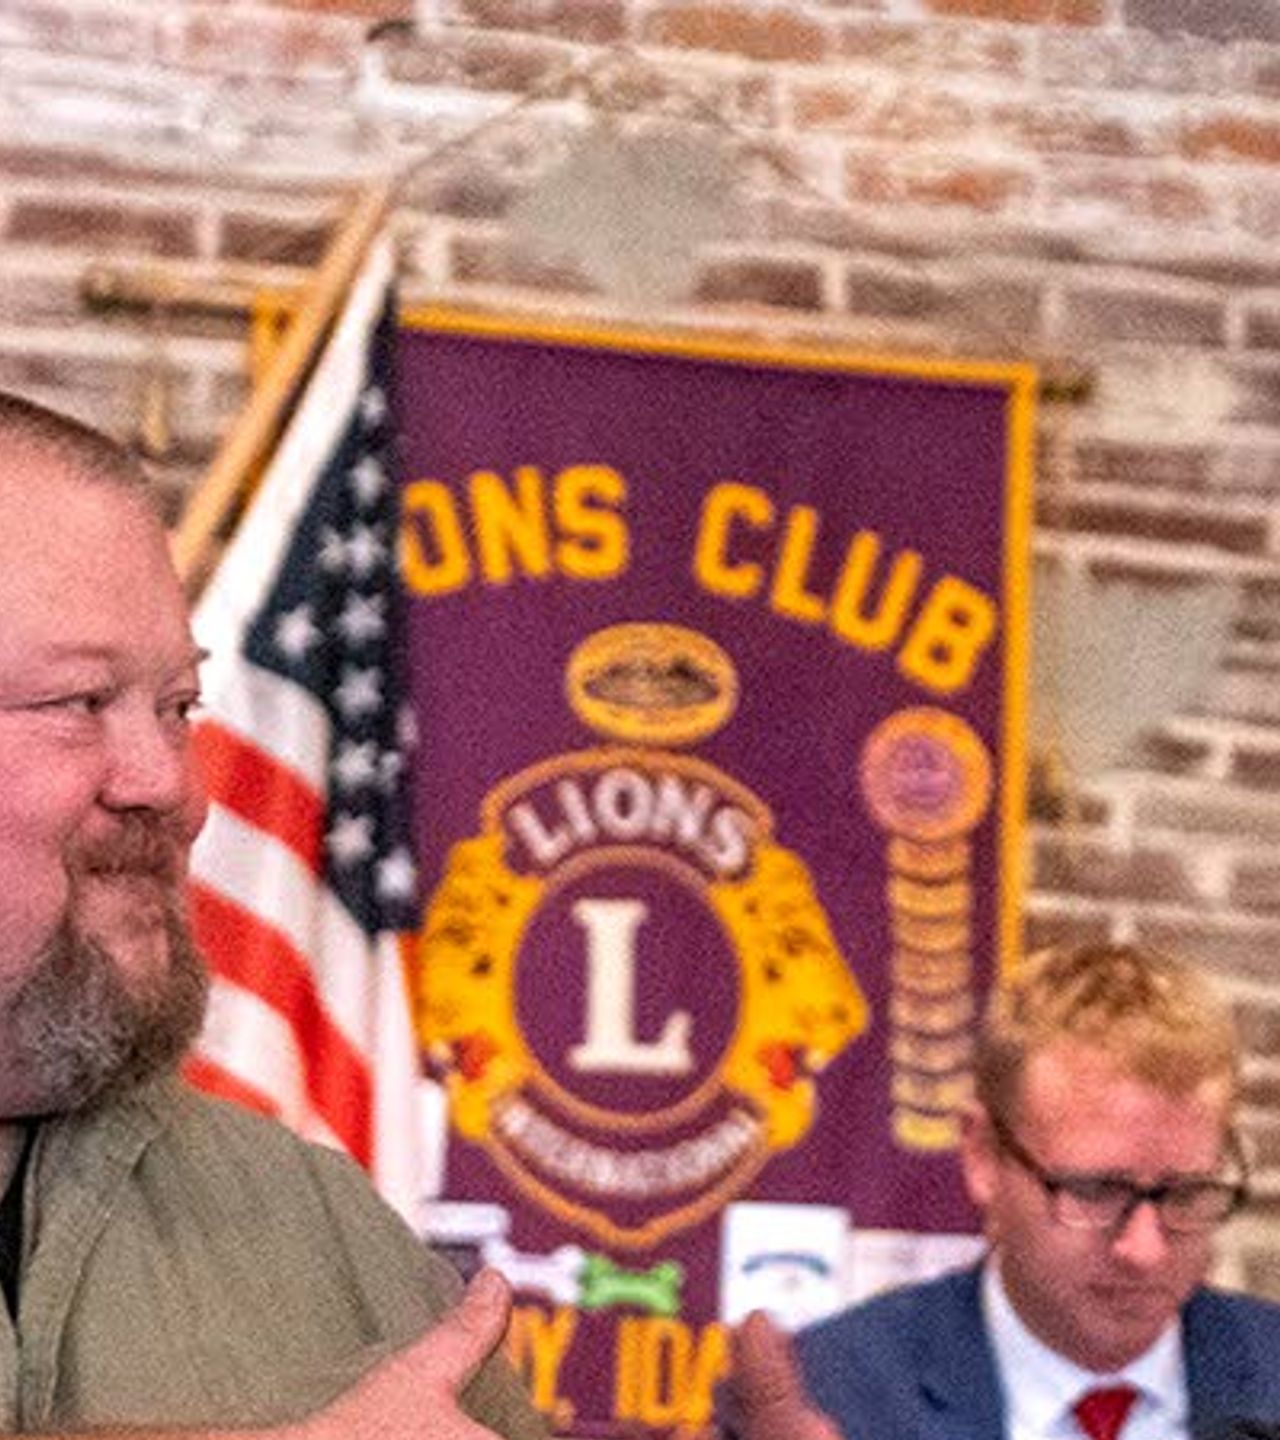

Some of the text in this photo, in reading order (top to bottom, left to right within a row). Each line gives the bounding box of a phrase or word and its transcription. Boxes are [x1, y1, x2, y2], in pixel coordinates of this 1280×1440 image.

[695, 481, 997, 695] CLUB
[509, 767, 751, 879] LIONS
[566, 899, 693, 1076] L
